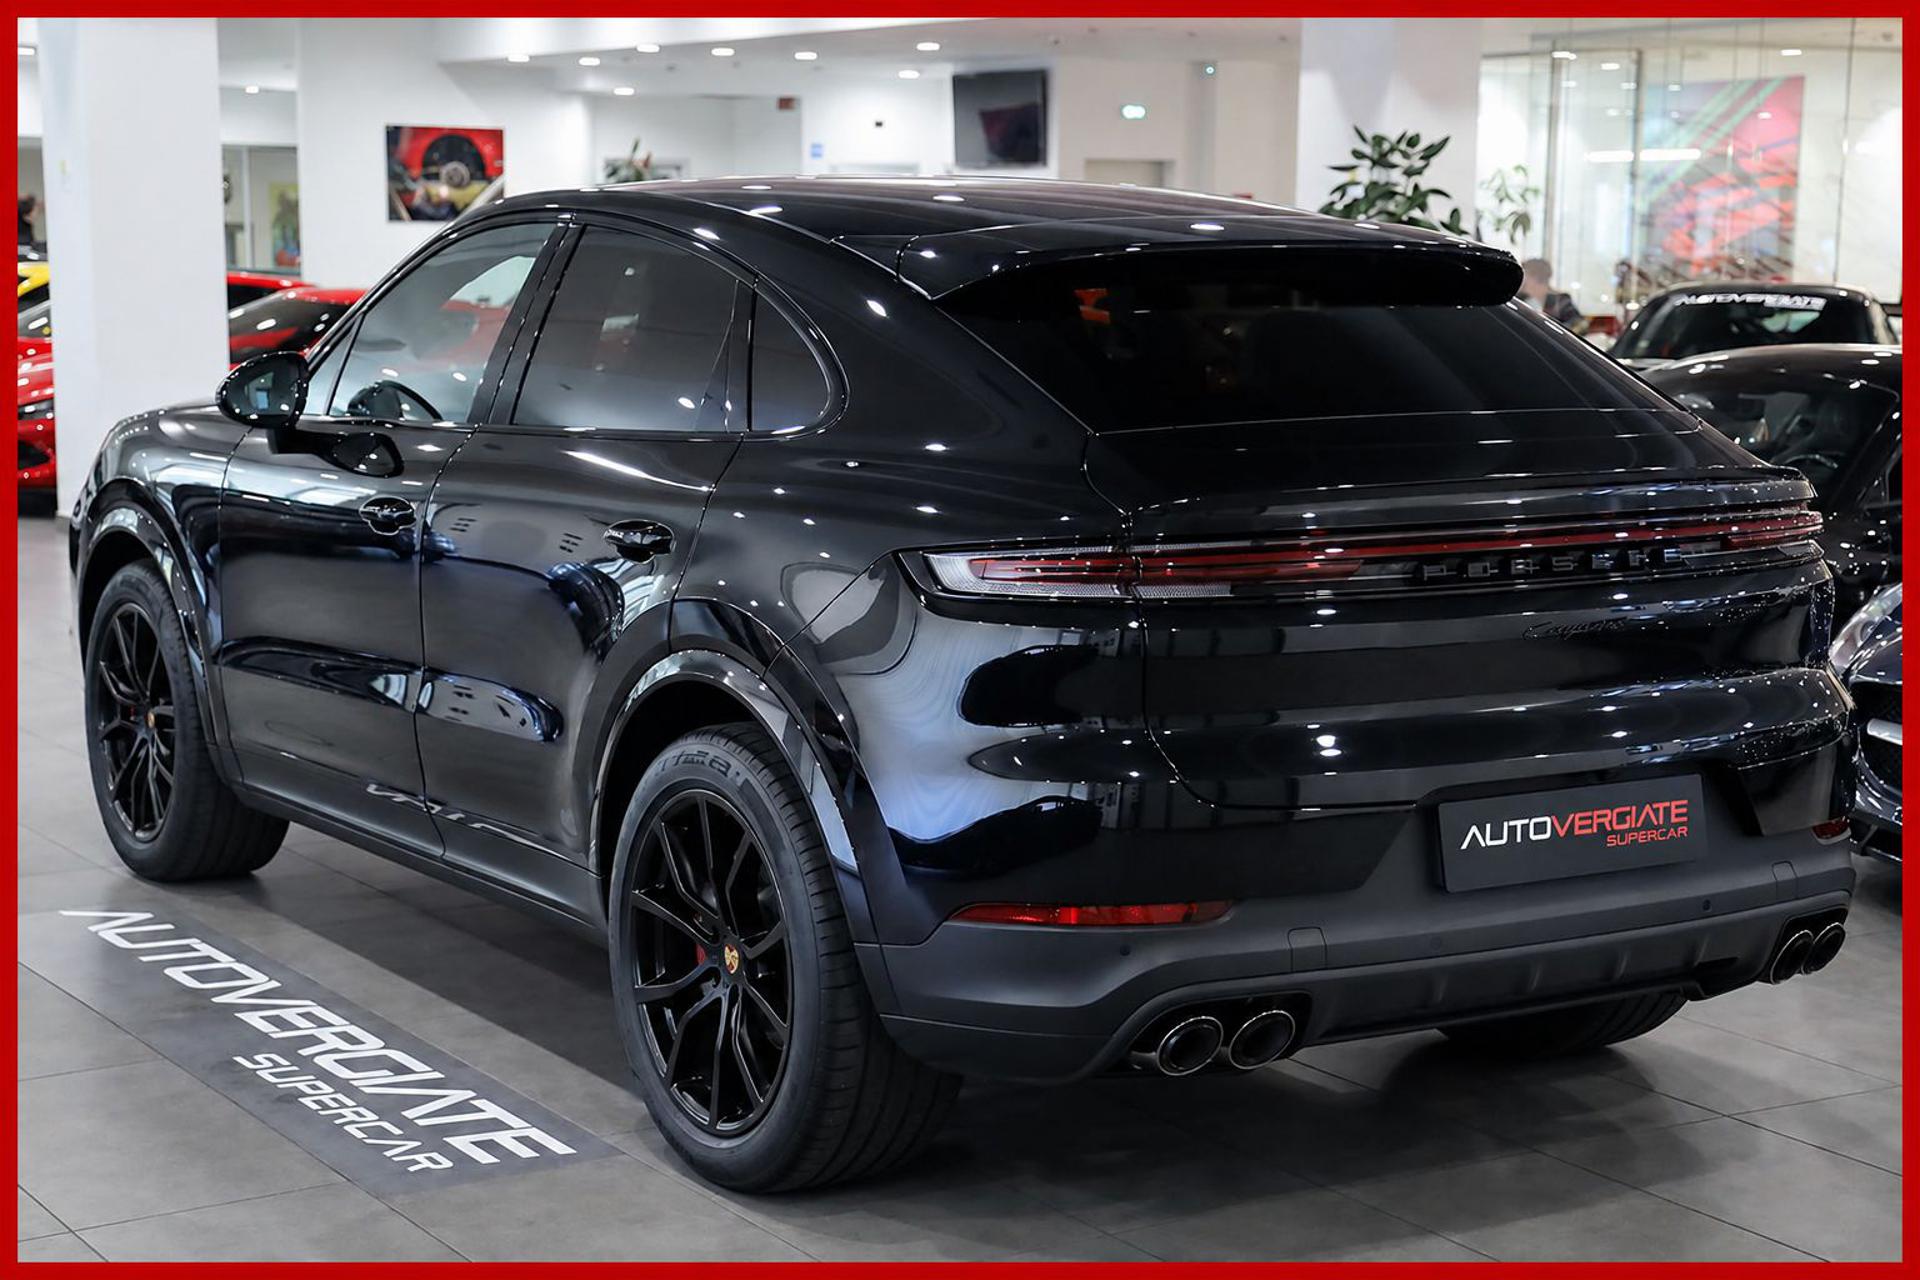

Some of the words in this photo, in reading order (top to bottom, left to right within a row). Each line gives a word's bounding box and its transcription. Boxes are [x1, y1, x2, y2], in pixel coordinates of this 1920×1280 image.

[1460, 800, 1689, 850] AUTOVERGIATE
[1606, 826, 1688, 848] SUPERCAR
[58, 909, 577, 1165] AUTOVERGIATE
[232, 1053, 454, 1172] SUPERCAR
